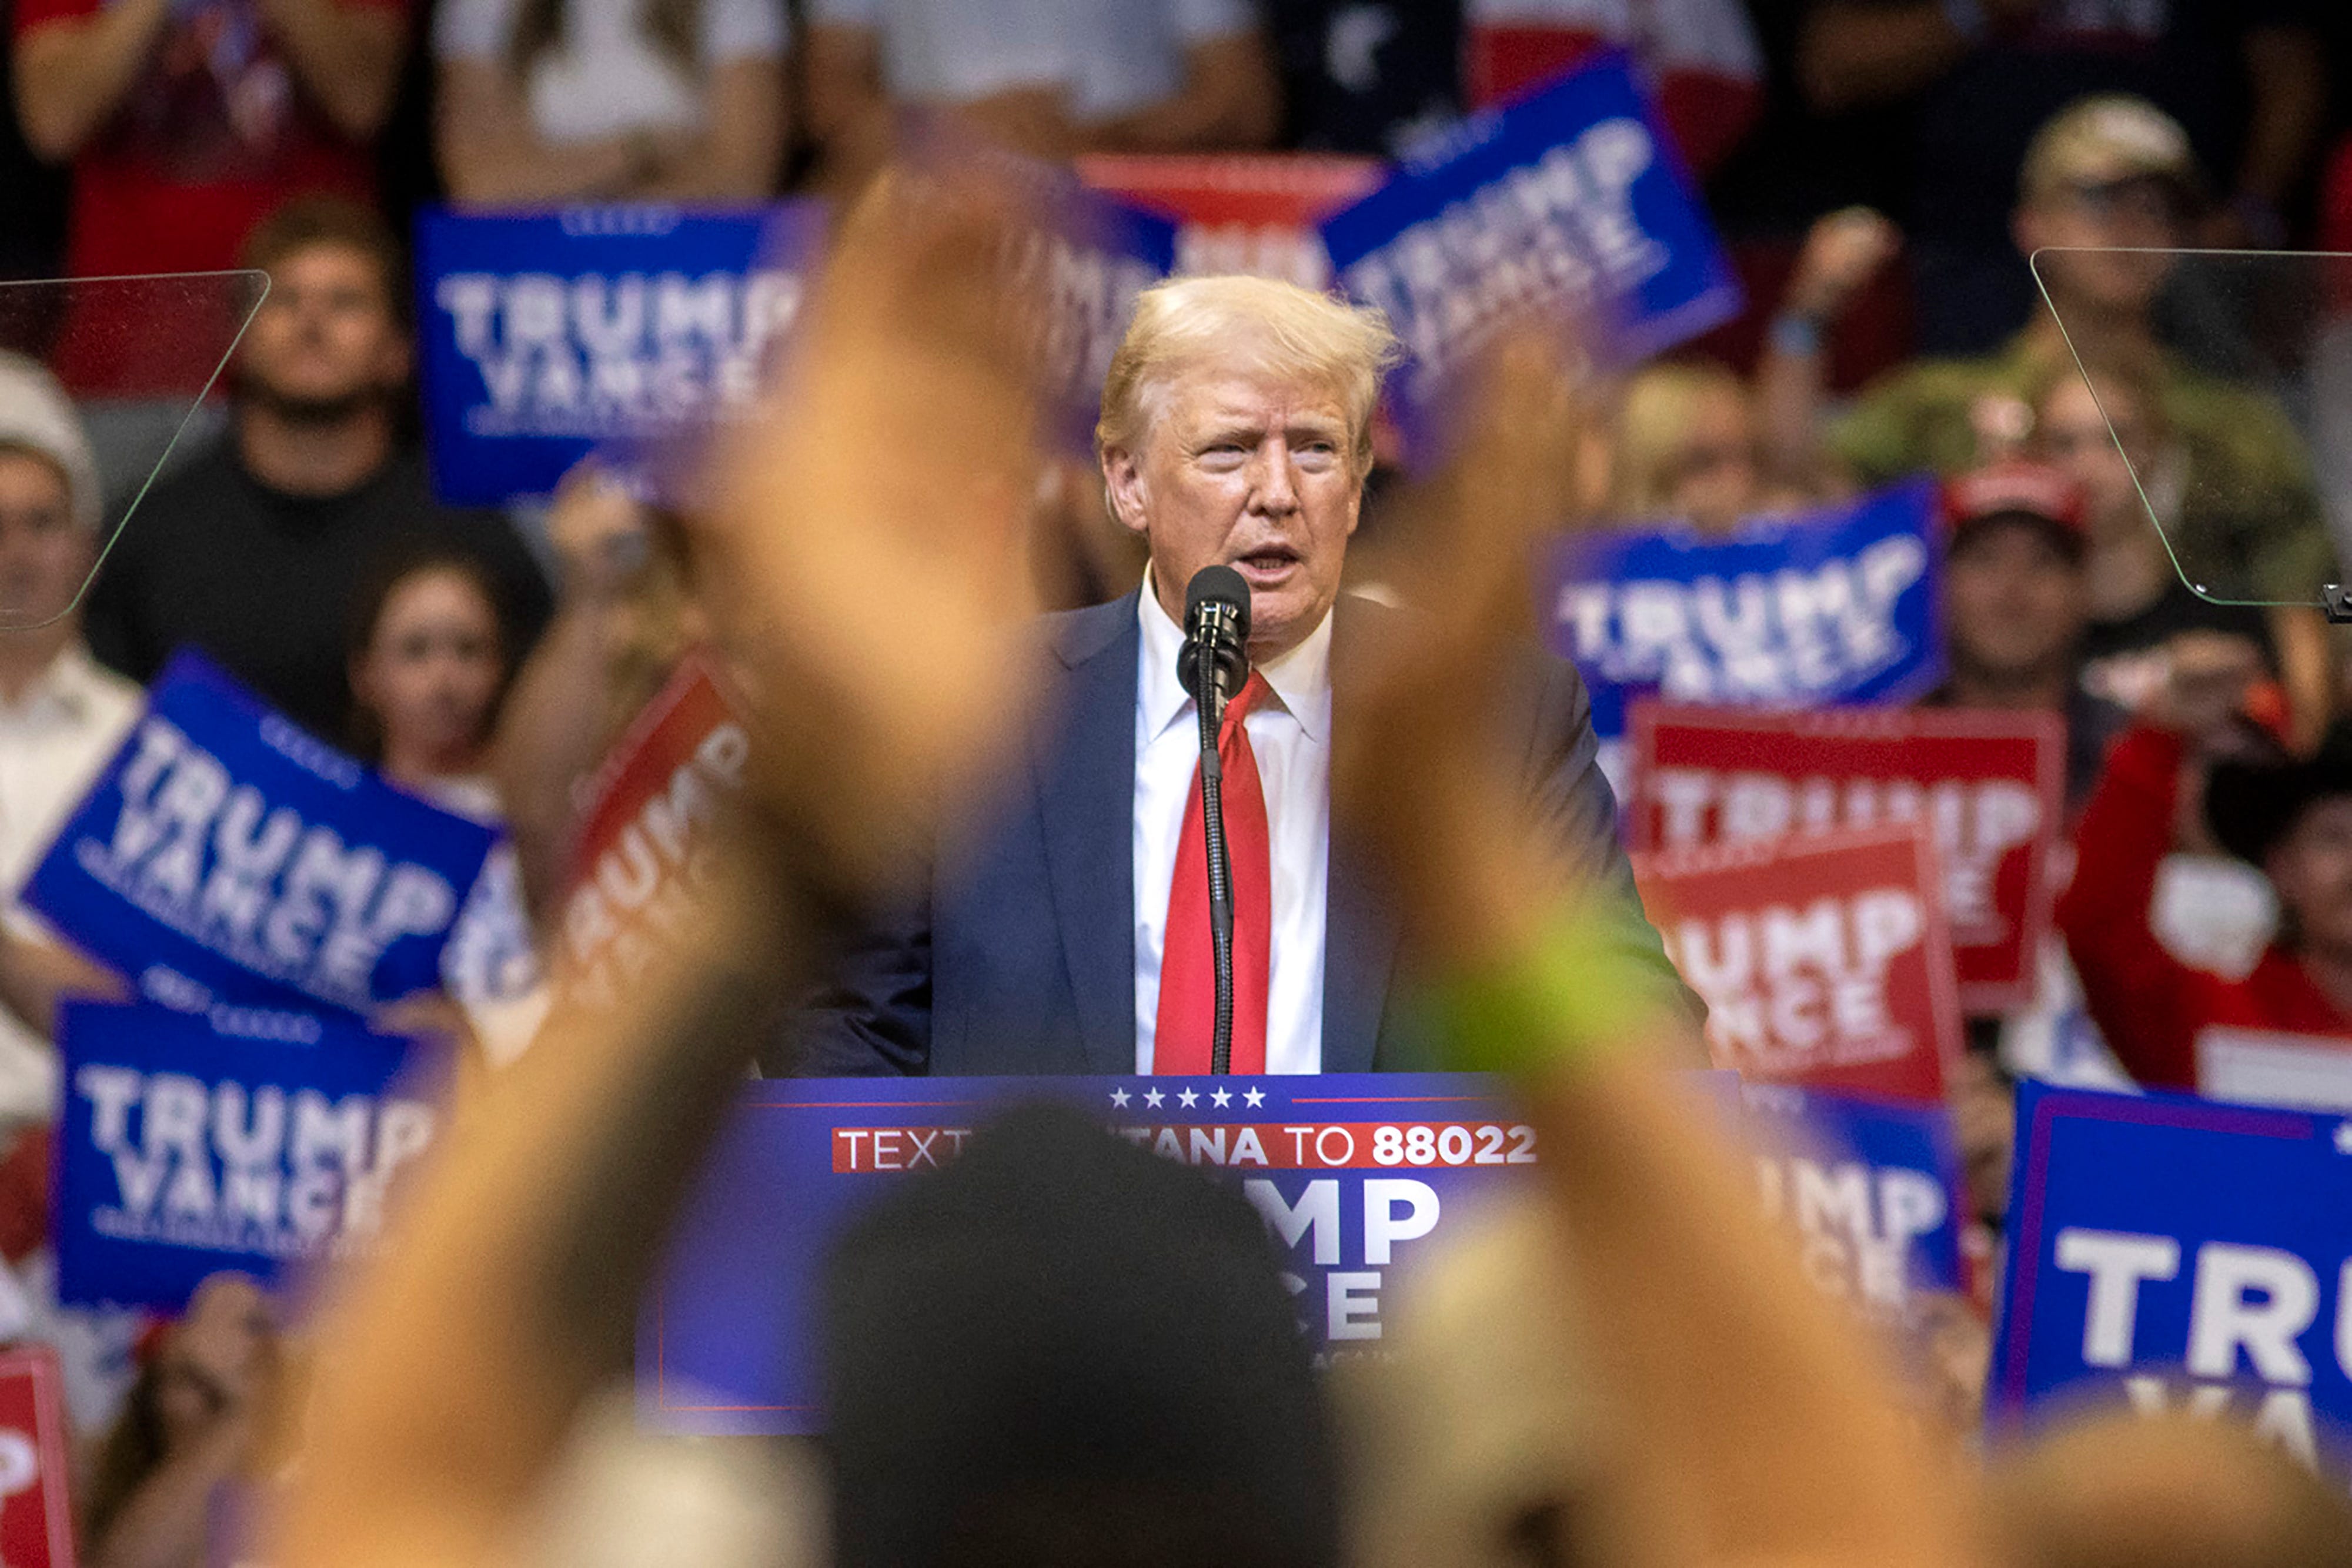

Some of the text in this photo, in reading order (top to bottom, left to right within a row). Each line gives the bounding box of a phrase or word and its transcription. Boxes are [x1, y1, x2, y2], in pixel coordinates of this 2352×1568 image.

[434, 270, 801, 357] TRUMP
[1555, 531, 1929, 661] TRUMP
[121, 713, 459, 938] TRUMP
[112, 808, 388, 997] VANCE
[1675, 887, 1924, 998] UMP
[76, 1063, 435, 1176] TRUMP
[838, 1130, 972, 1169] TEXT
[1284, 1126, 1354, 1166] TO
[1372, 1125, 1537, 1165] 88022
[1243, 1178, 1441, 1265] MP
[2054, 1226, 2352, 1389] TR
